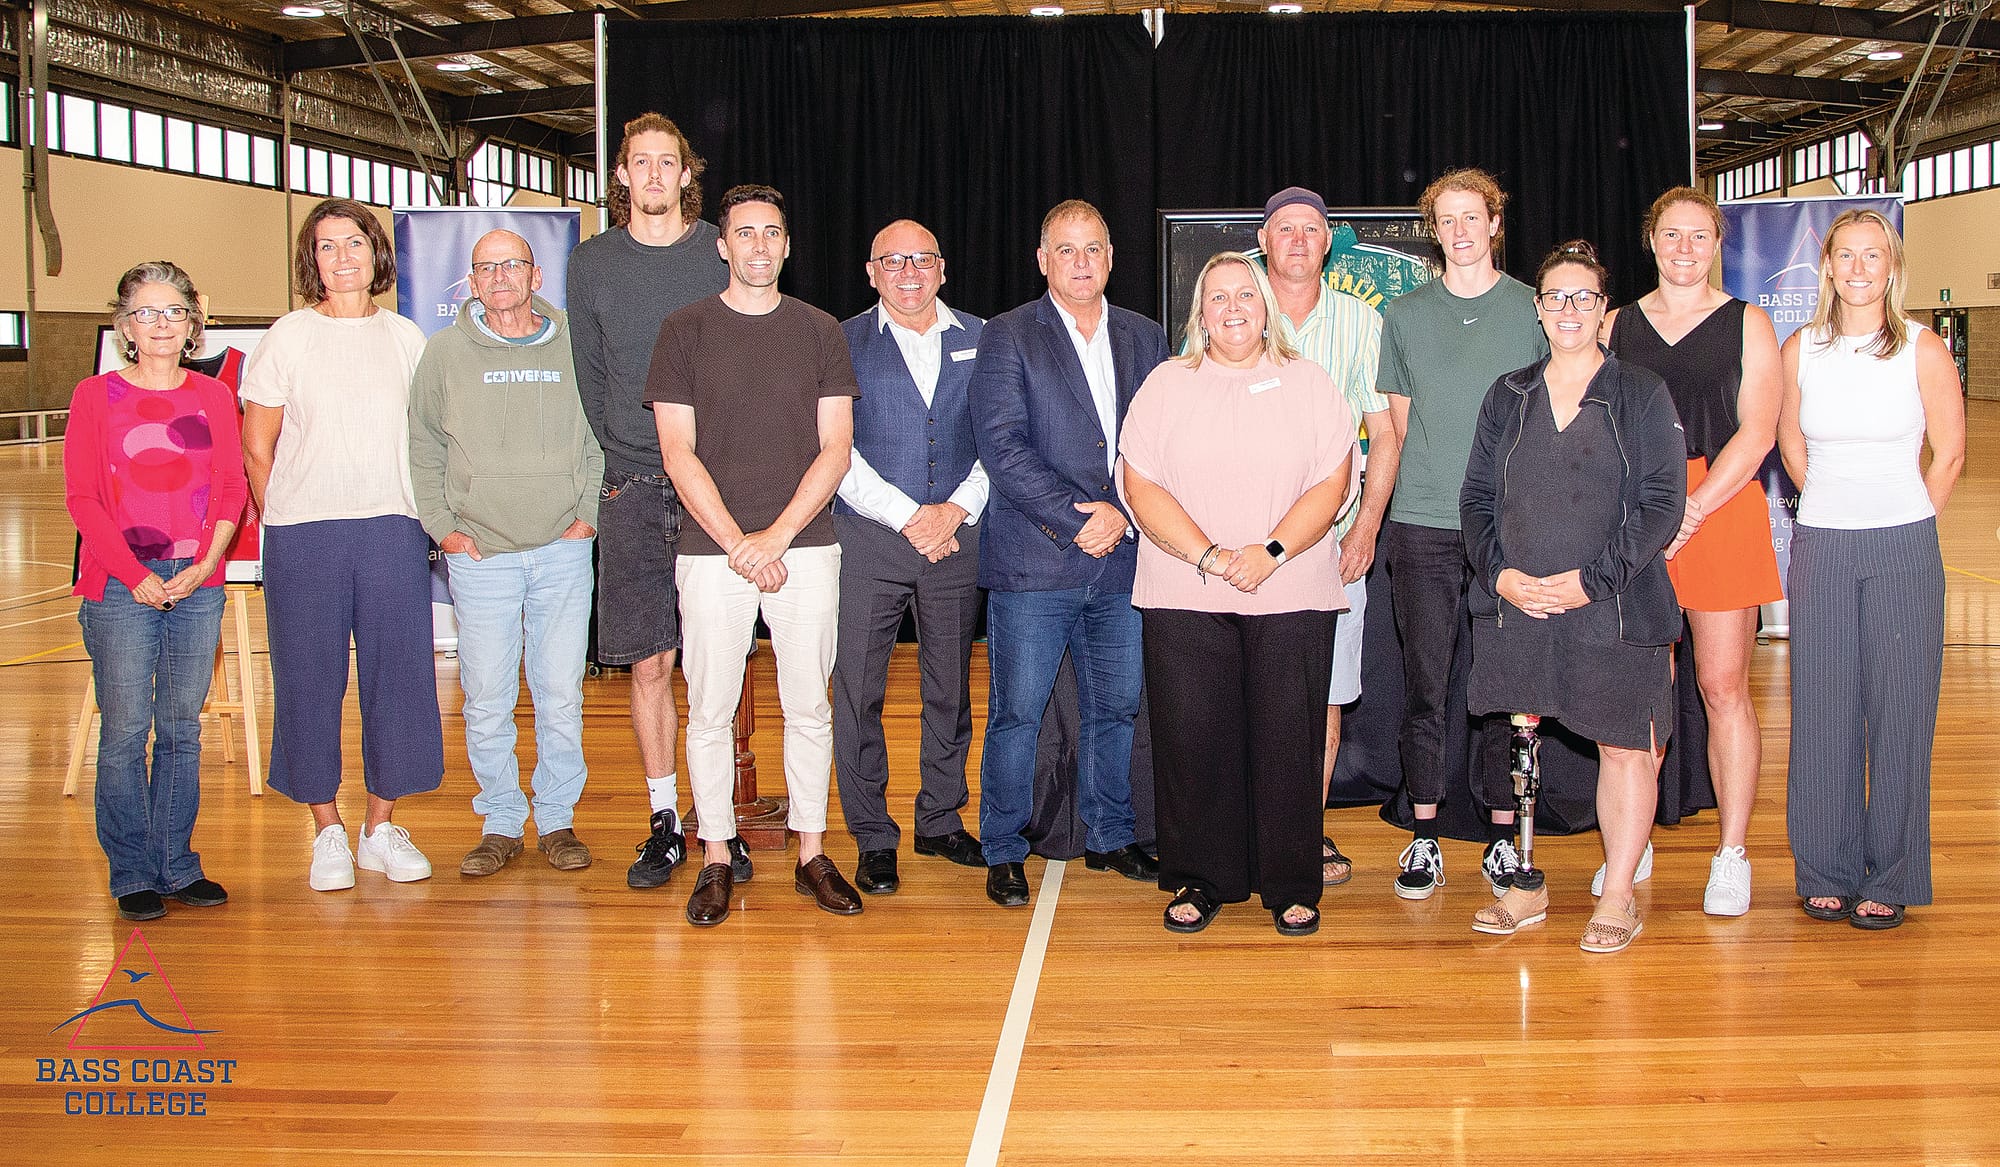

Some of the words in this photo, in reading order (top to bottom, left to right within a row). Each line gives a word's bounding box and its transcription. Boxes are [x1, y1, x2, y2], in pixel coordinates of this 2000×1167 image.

[1320, 271, 1384, 309] RALIA
[1758, 293, 1803, 307] BASS
[483, 369, 560, 384] CONVERSE
